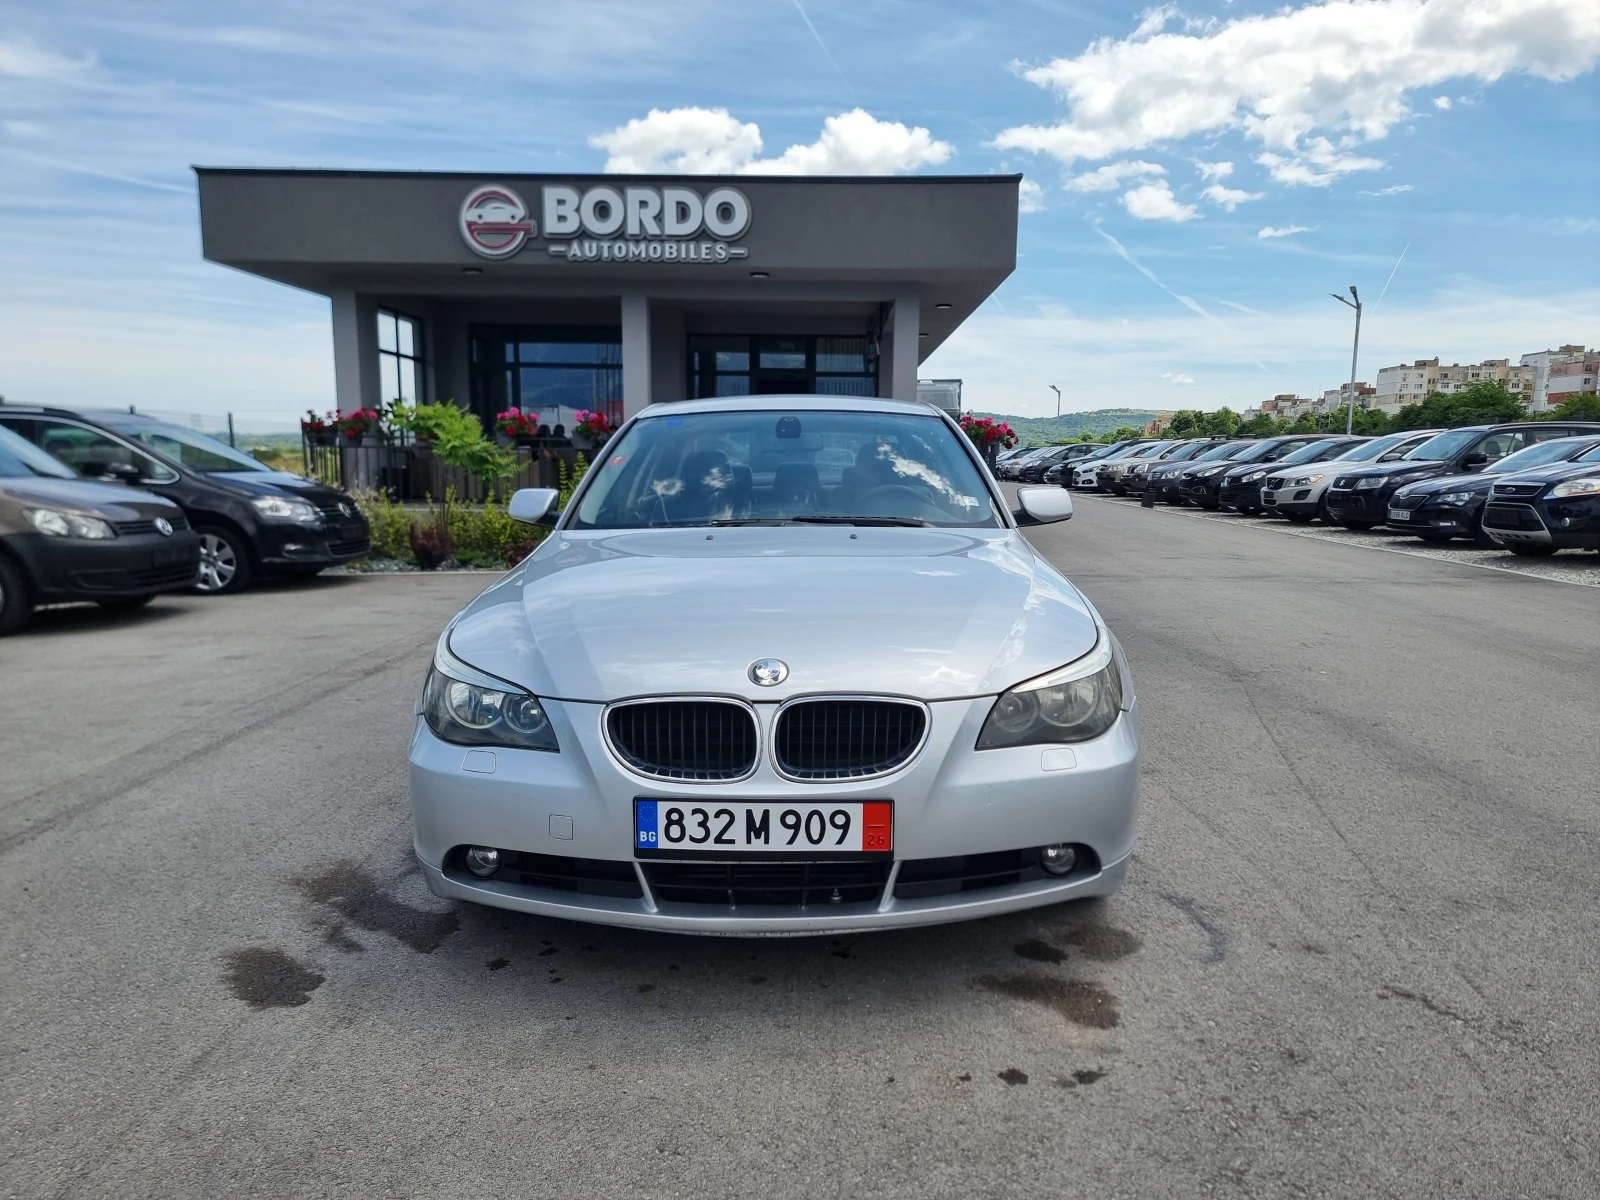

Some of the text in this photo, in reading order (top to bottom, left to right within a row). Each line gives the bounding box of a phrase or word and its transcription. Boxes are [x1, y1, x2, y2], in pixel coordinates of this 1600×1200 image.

[543, 187, 749, 236] BORDO
[567, 241, 728, 260] AUTOMOBILES
[663, 807, 852, 846] 832 M 909
[639, 831, 657, 842] BG
[867, 832, 885, 846] 26
